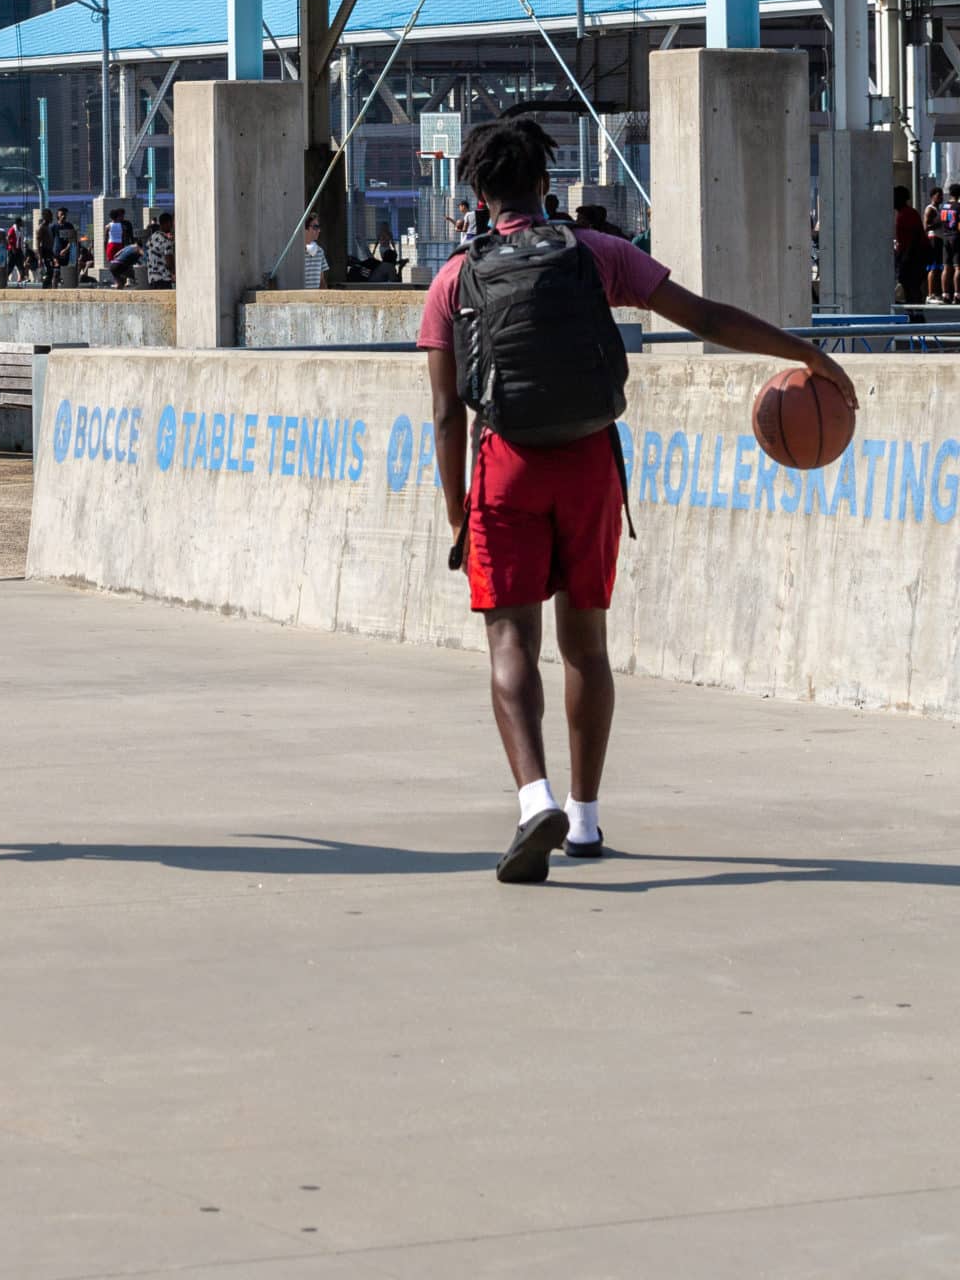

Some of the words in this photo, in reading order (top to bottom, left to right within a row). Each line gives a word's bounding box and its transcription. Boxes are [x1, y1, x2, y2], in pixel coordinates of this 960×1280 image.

[74, 406, 142, 463] BOCCE
[182, 412, 258, 472] TABLE
[267, 416, 365, 481] TENNIS
